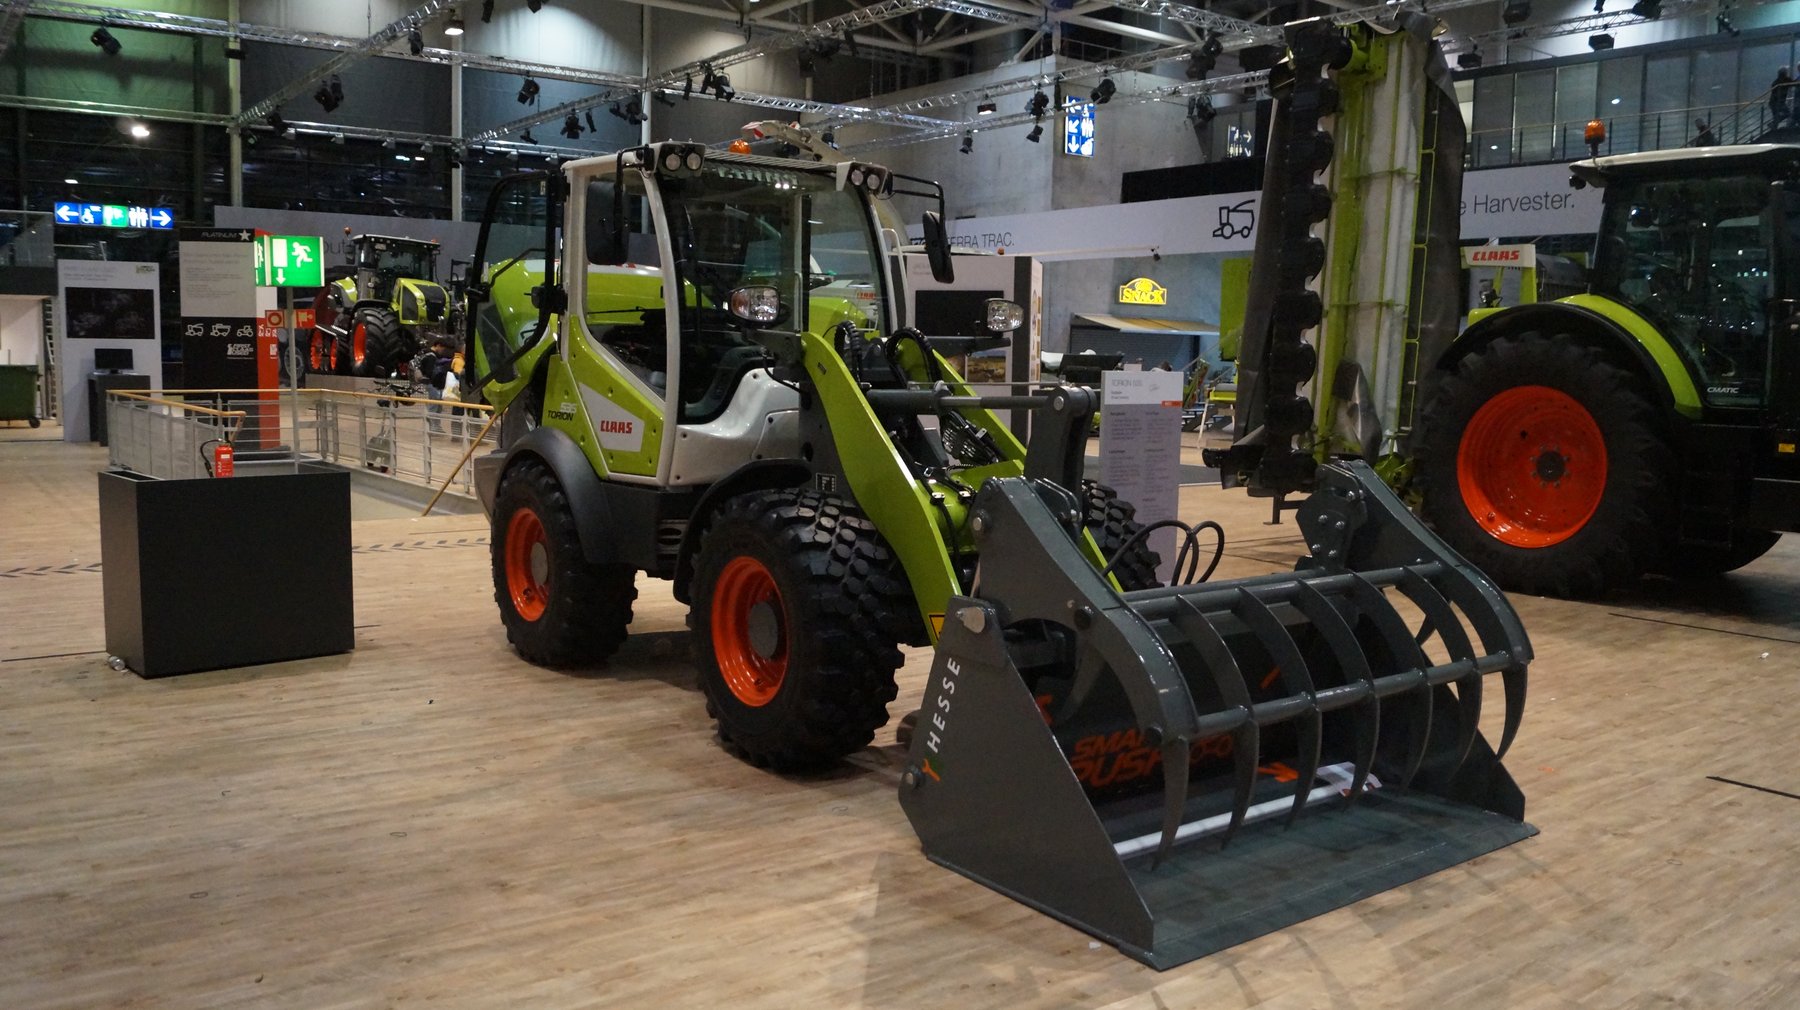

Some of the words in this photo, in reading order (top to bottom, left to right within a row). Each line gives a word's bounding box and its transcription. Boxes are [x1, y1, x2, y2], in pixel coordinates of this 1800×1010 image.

[1473, 191, 1575, 214] Harvester.
[947, 235, 979, 248] ERRA
[982, 232, 1015, 248] TRAC.
[1472, 250, 1520, 261] CLAAS
[1123, 288, 1163, 303] SNACK
[547, 410, 574, 421] TORION
[600, 420, 632, 434] CLAAS
[926, 657, 961, 753] HESSE
